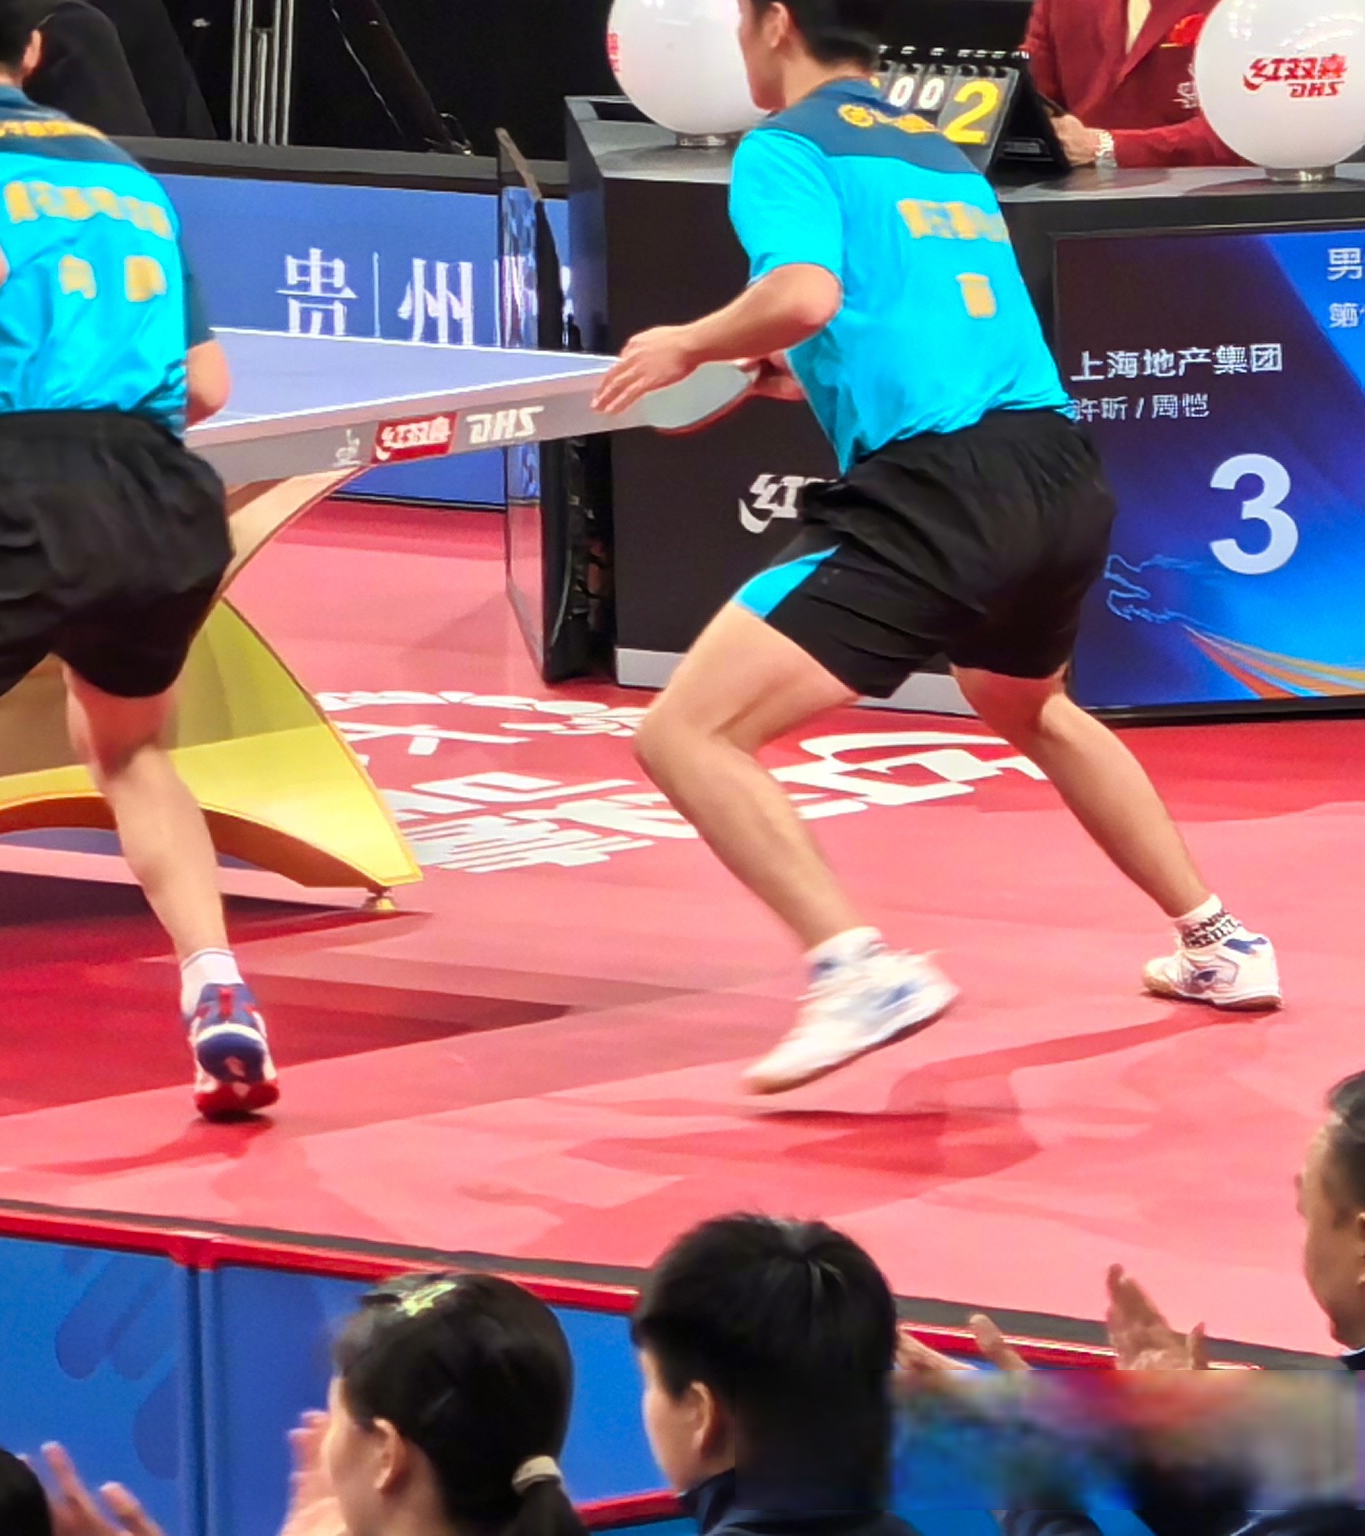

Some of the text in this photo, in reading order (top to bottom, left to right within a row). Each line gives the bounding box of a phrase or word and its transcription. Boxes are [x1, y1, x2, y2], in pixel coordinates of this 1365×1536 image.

[943, 79, 999, 145] 2
[1070, 342, 1284, 382] 上海地产集团
[466, 405, 545, 445] DHS
[1209, 453, 1300, 575] 3
